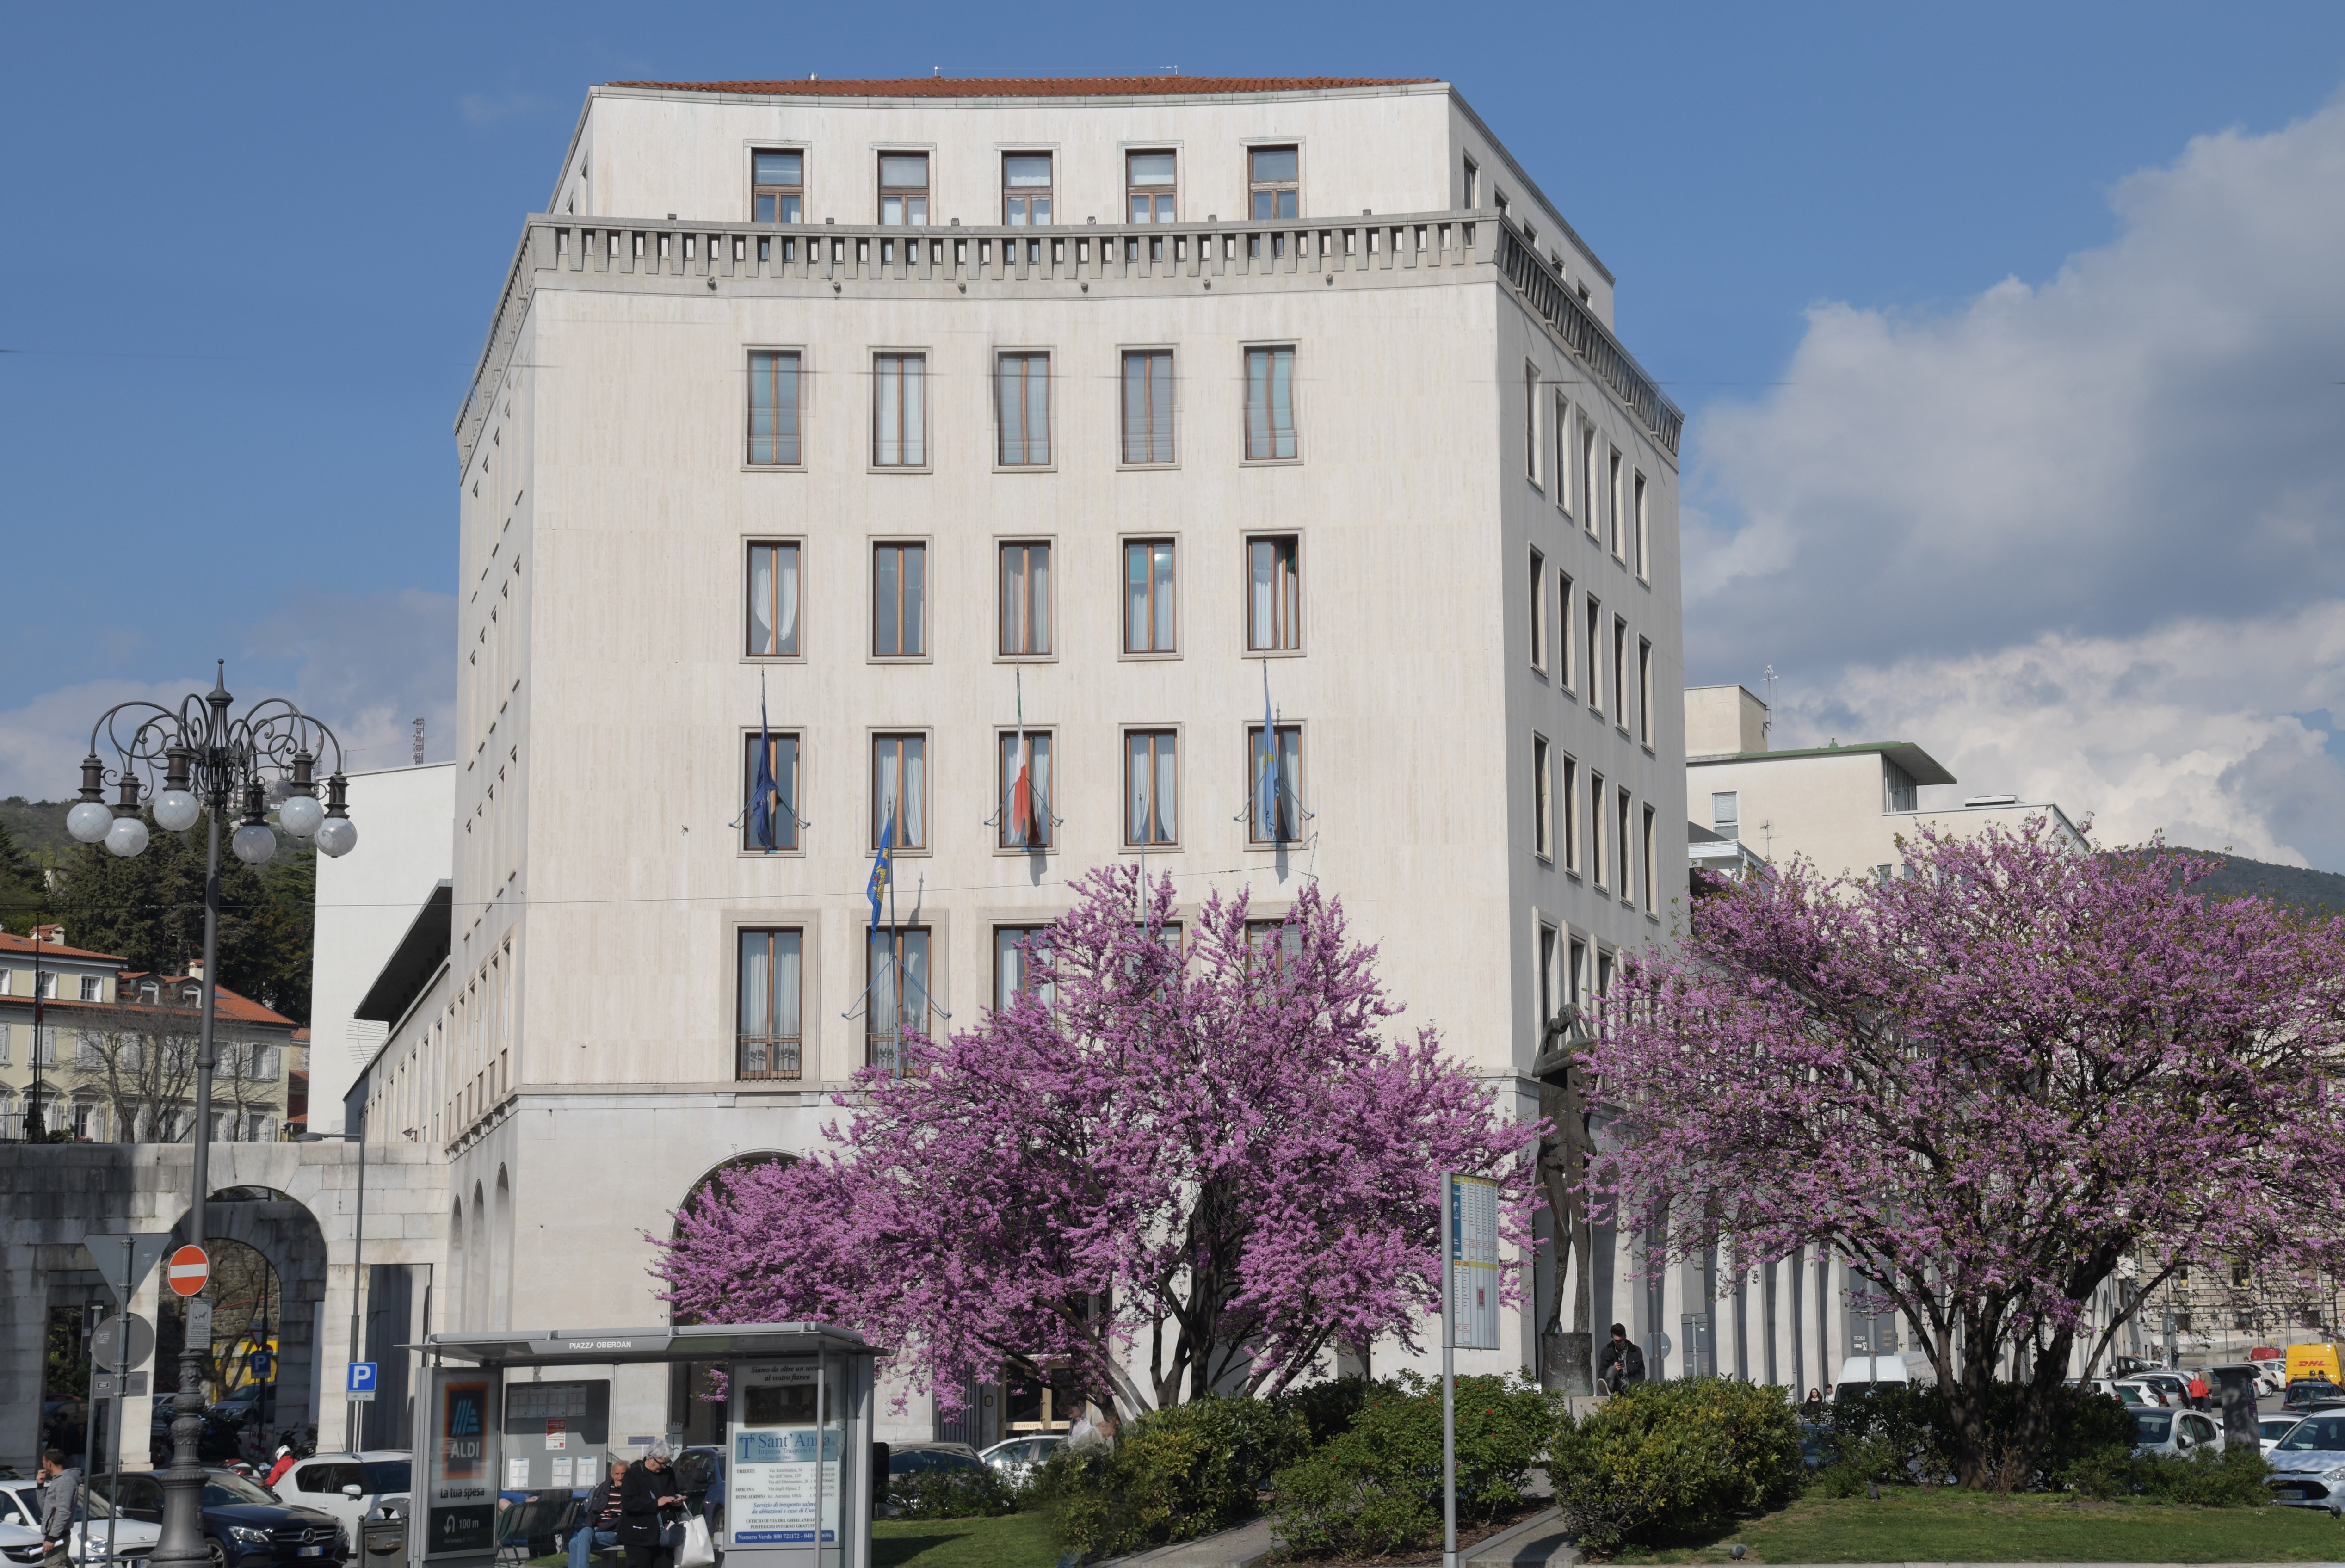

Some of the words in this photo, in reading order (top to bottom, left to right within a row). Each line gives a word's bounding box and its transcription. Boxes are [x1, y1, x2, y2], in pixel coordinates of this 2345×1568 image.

[255, 1355, 267, 1370] P
[353, 1365, 371, 1389] P
[2248, 1382, 2252, 1395] P
[450, 1441, 480, 1458] ALDI
[440, 1488, 448, 1499] La
[450, 1487, 462, 1498] tua
[464, 1487, 485, 1500] spesa
[459, 1519, 471, 1530] 100
[472, 1519, 479, 1528] m
